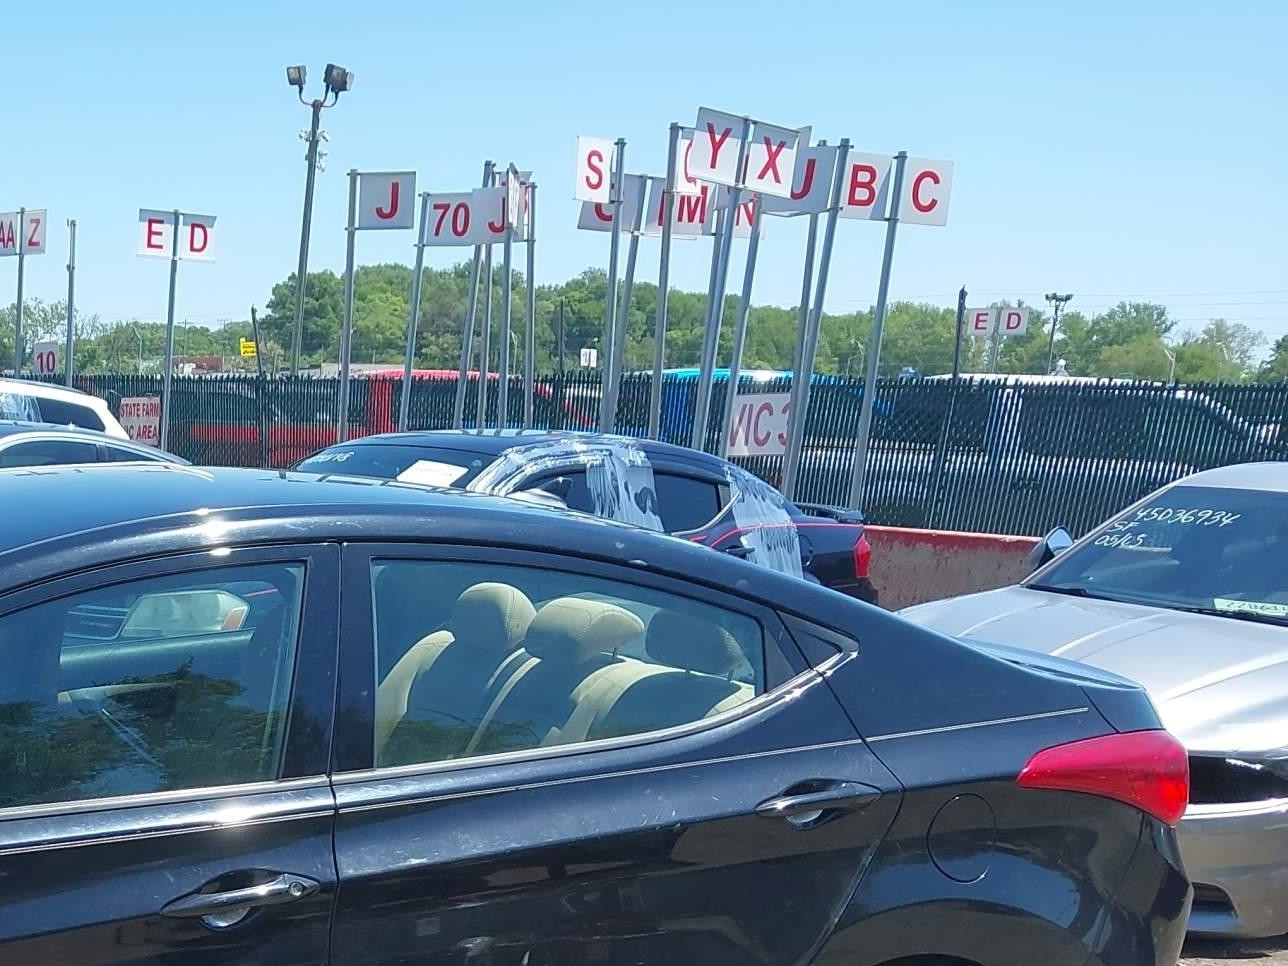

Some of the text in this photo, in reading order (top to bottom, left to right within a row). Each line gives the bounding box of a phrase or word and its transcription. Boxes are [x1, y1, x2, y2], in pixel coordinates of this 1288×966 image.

[707, 122, 733, 169] Y
[757, 135, 787, 184] X
[585, 150, 603, 190] S
[790, 158, 816, 200] J
[848, 164, 877, 206] B
[375, 181, 399, 220] J
[677, 185, 708, 224] M
[912, 170, 940, 213] C
[27, 218, 41, 247] Z
[433, 202, 470, 237] 70
[488, 197, 505, 233] J
[146, 218, 165, 250] E
[189, 223, 208, 253] D
[974, 312, 989, 331] E
[1006, 312, 1022, 331] D
[37, 350, 56, 373] 10
[120, 402, 140, 418] STATE
[136, 424, 158, 440] AREA
